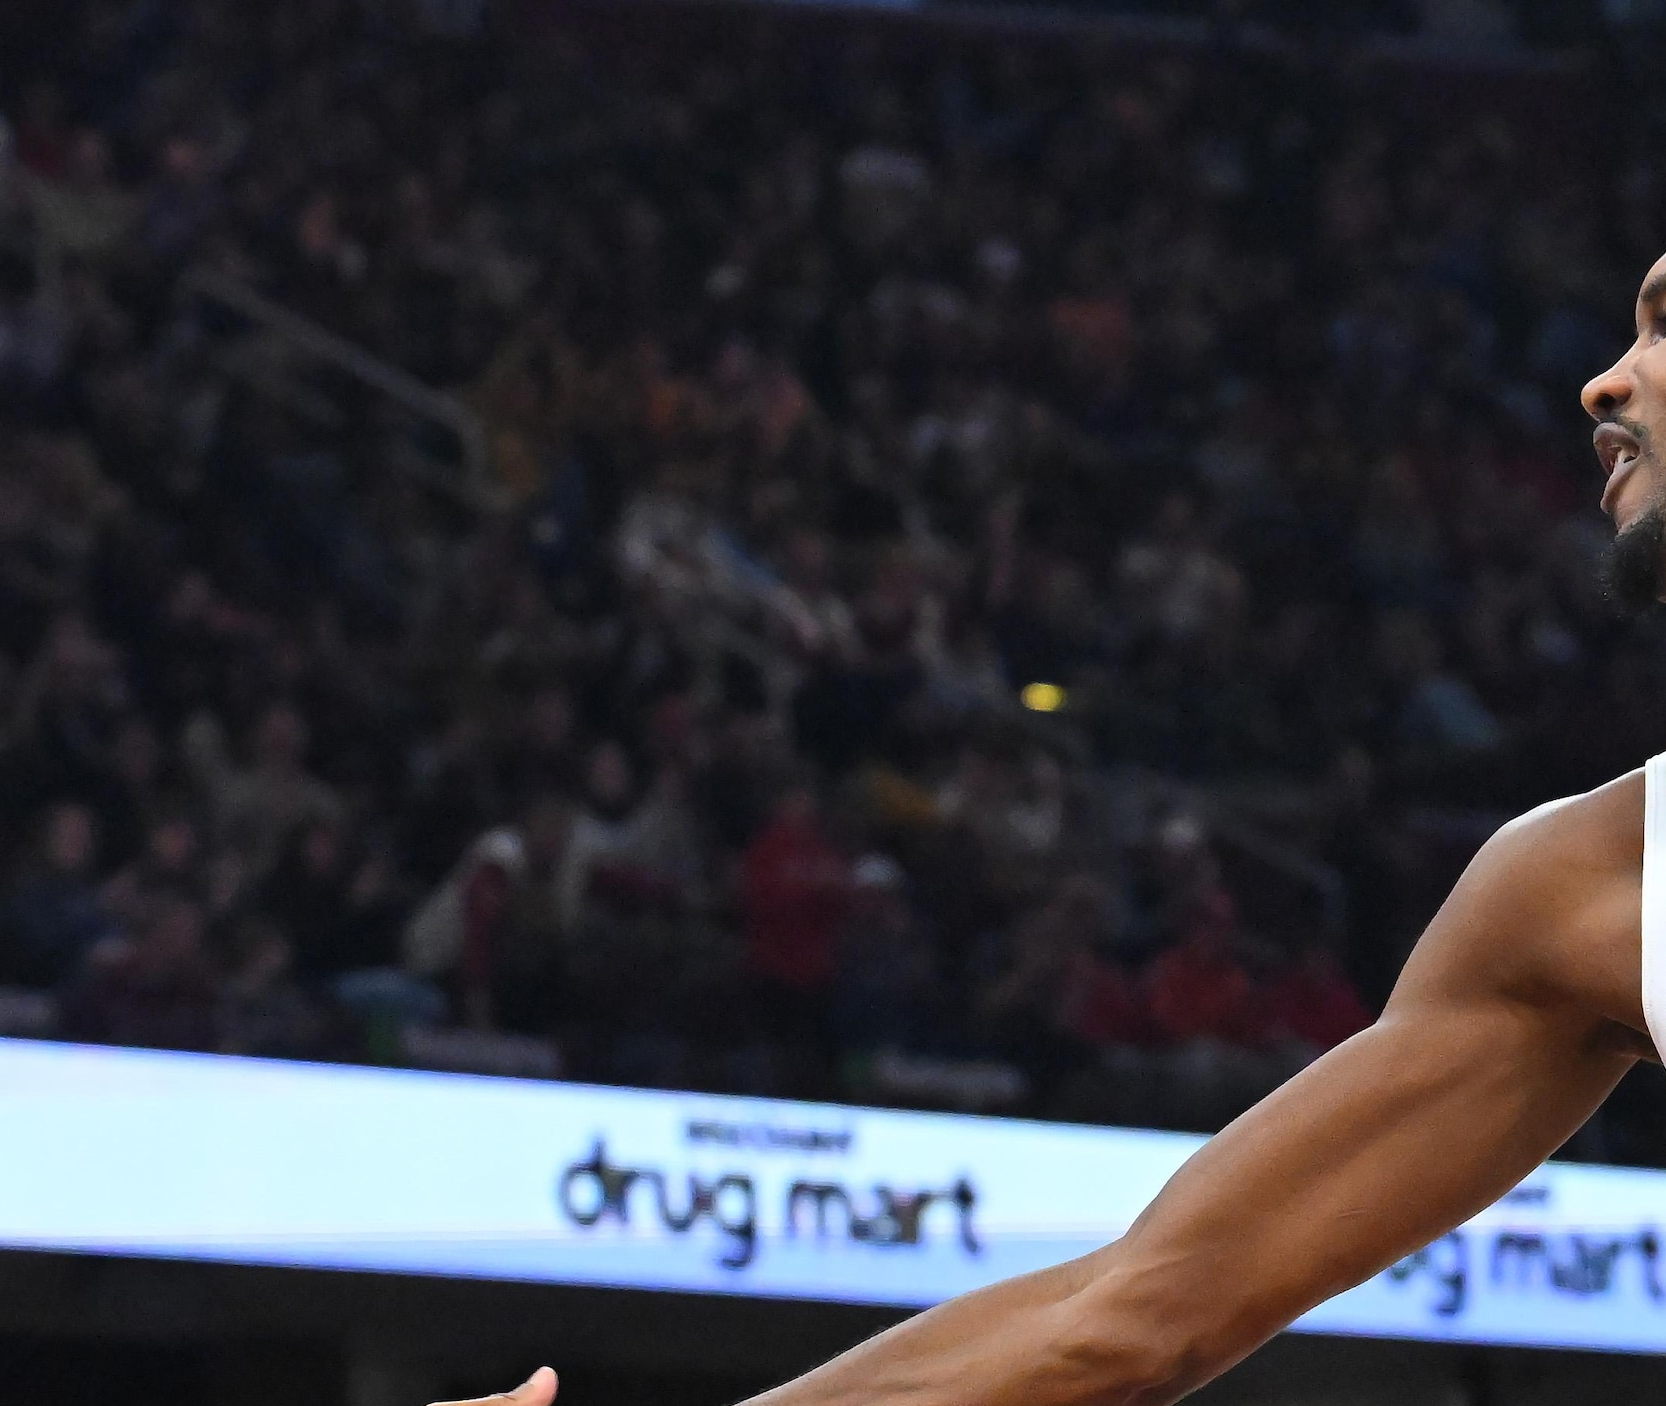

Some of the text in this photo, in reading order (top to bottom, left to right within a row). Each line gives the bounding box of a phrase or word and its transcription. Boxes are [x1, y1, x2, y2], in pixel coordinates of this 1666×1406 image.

[561, 1138, 983, 1269] drug mart
[1489, 1226, 1666, 1305] mart
